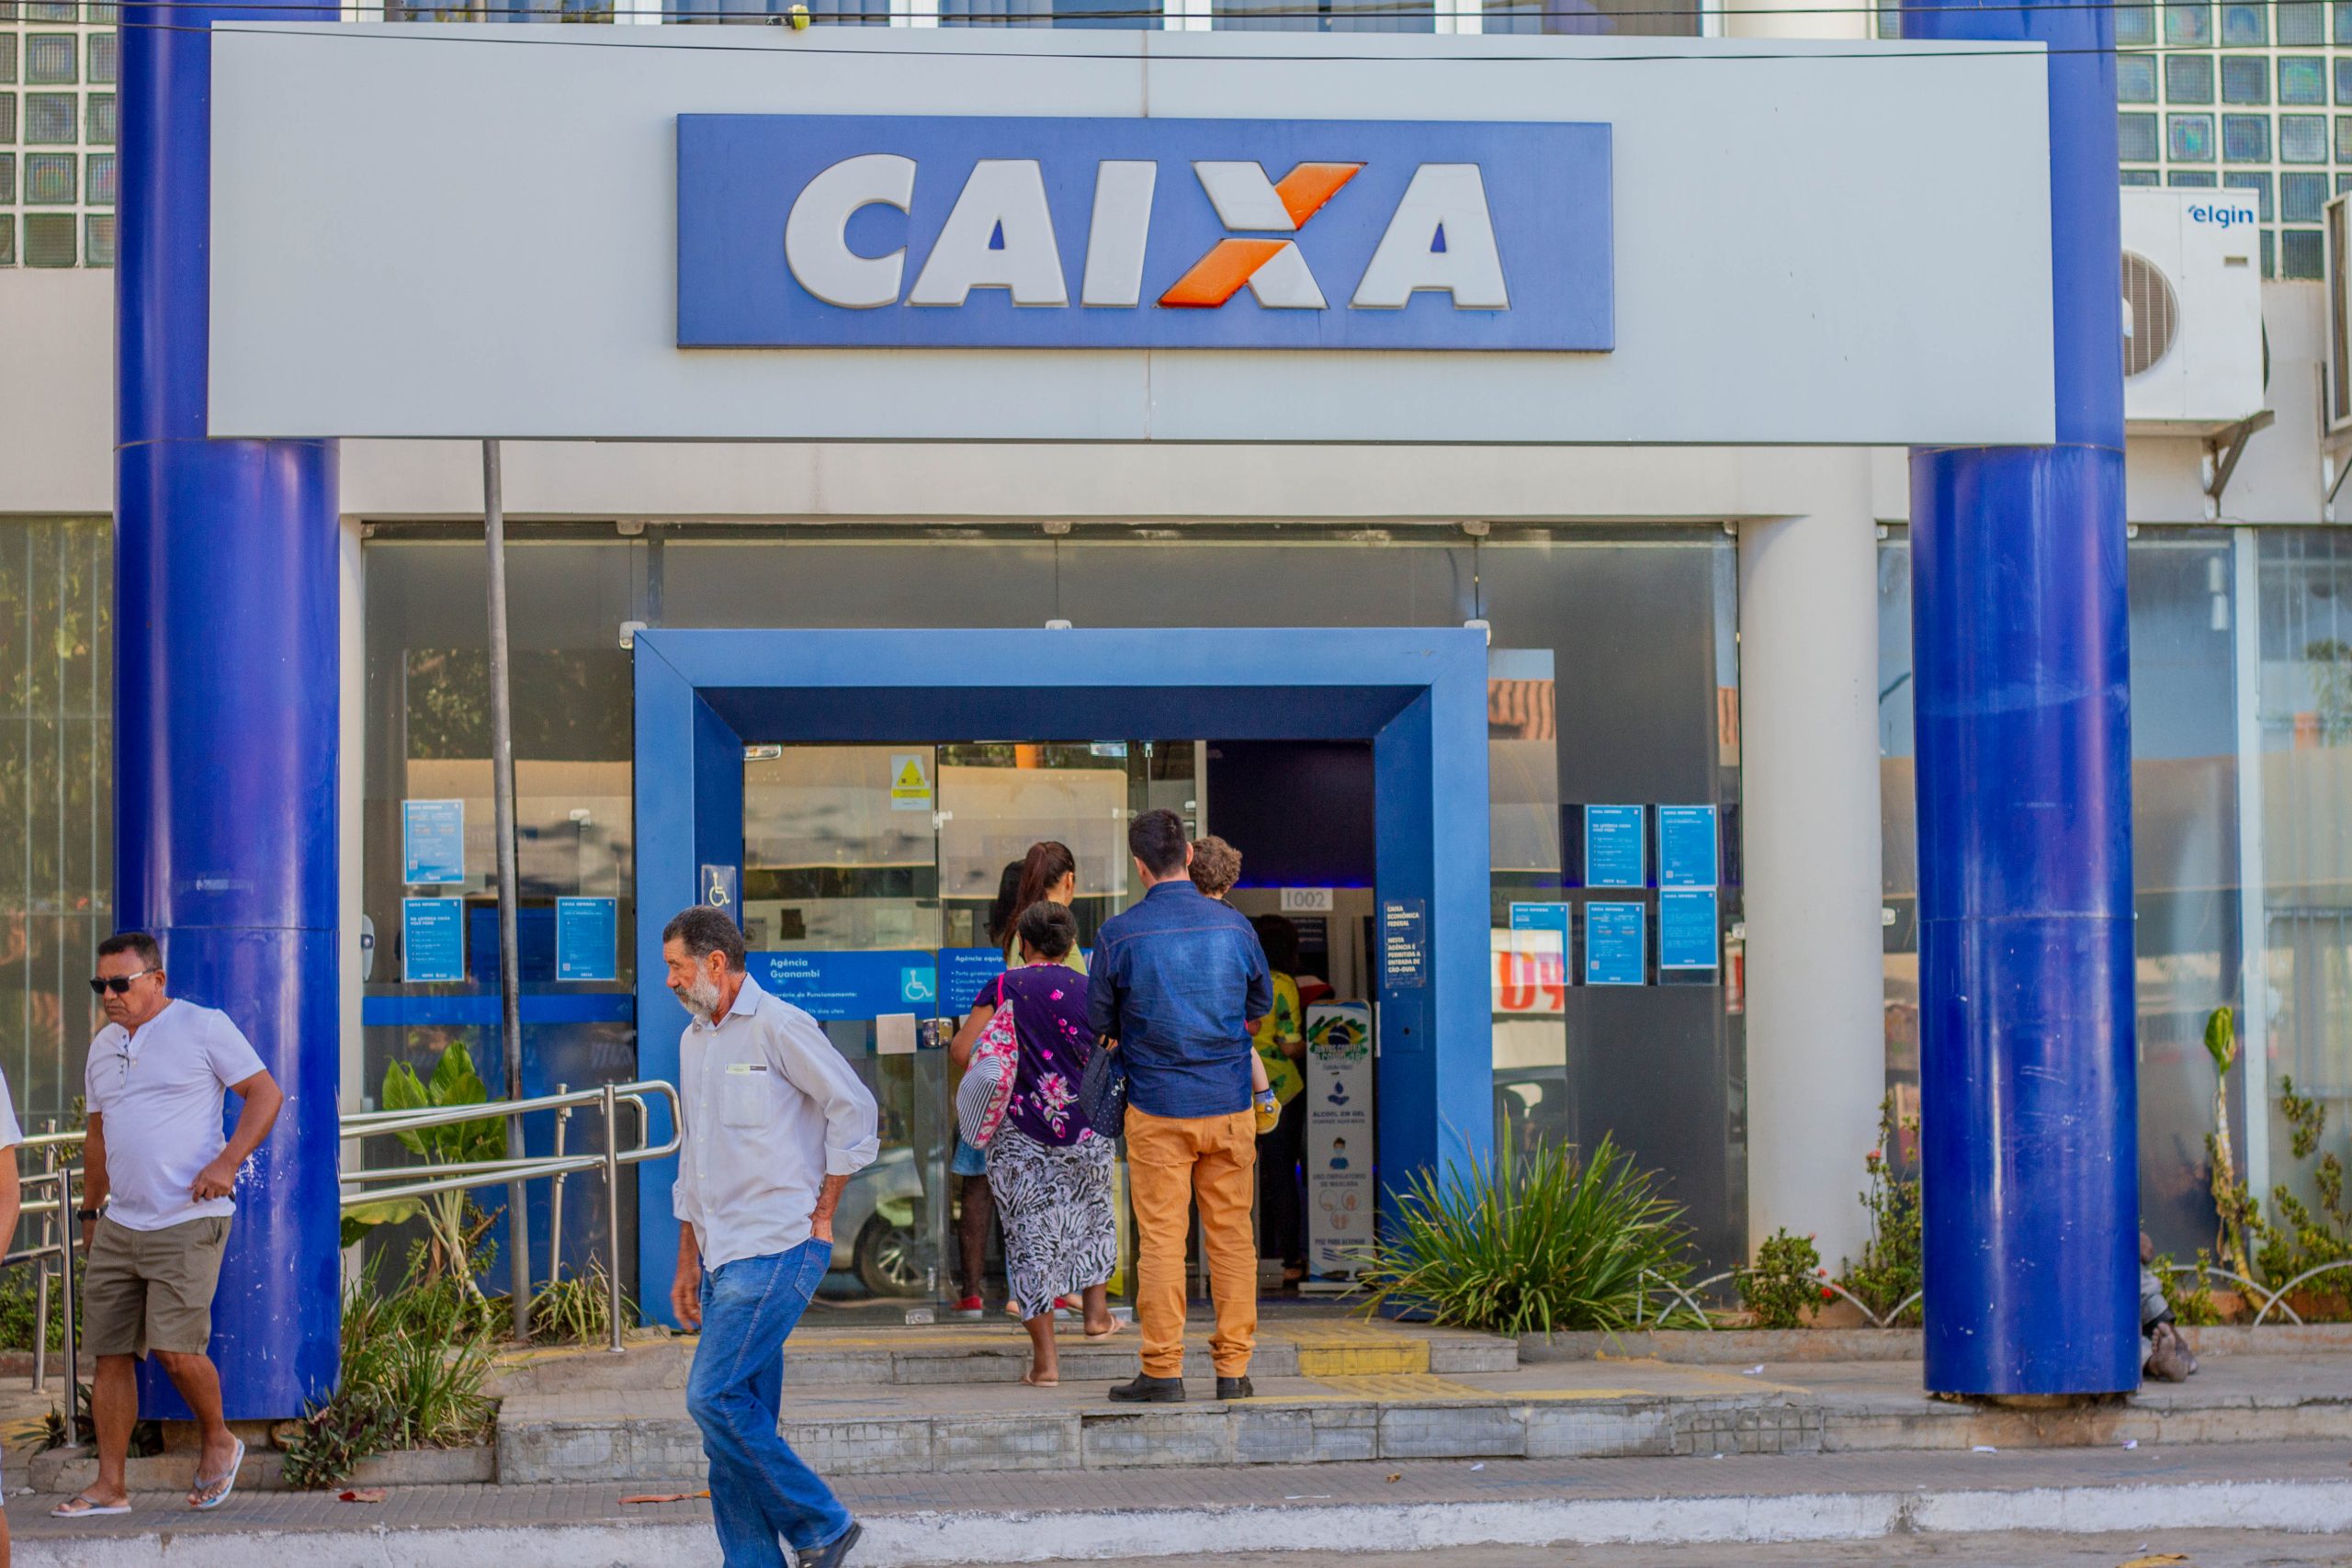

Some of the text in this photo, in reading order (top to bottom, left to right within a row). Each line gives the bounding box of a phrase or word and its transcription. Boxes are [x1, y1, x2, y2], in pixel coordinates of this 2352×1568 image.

[2192, 205, 2254, 229] elgin
[785, 152, 1511, 310] CAIXA
[1287, 891, 1325, 908] 1002
[770, 958, 808, 969] Agência
[956, 954, 1003, 963] Agência equip
[770, 969, 820, 978] Guanambi
